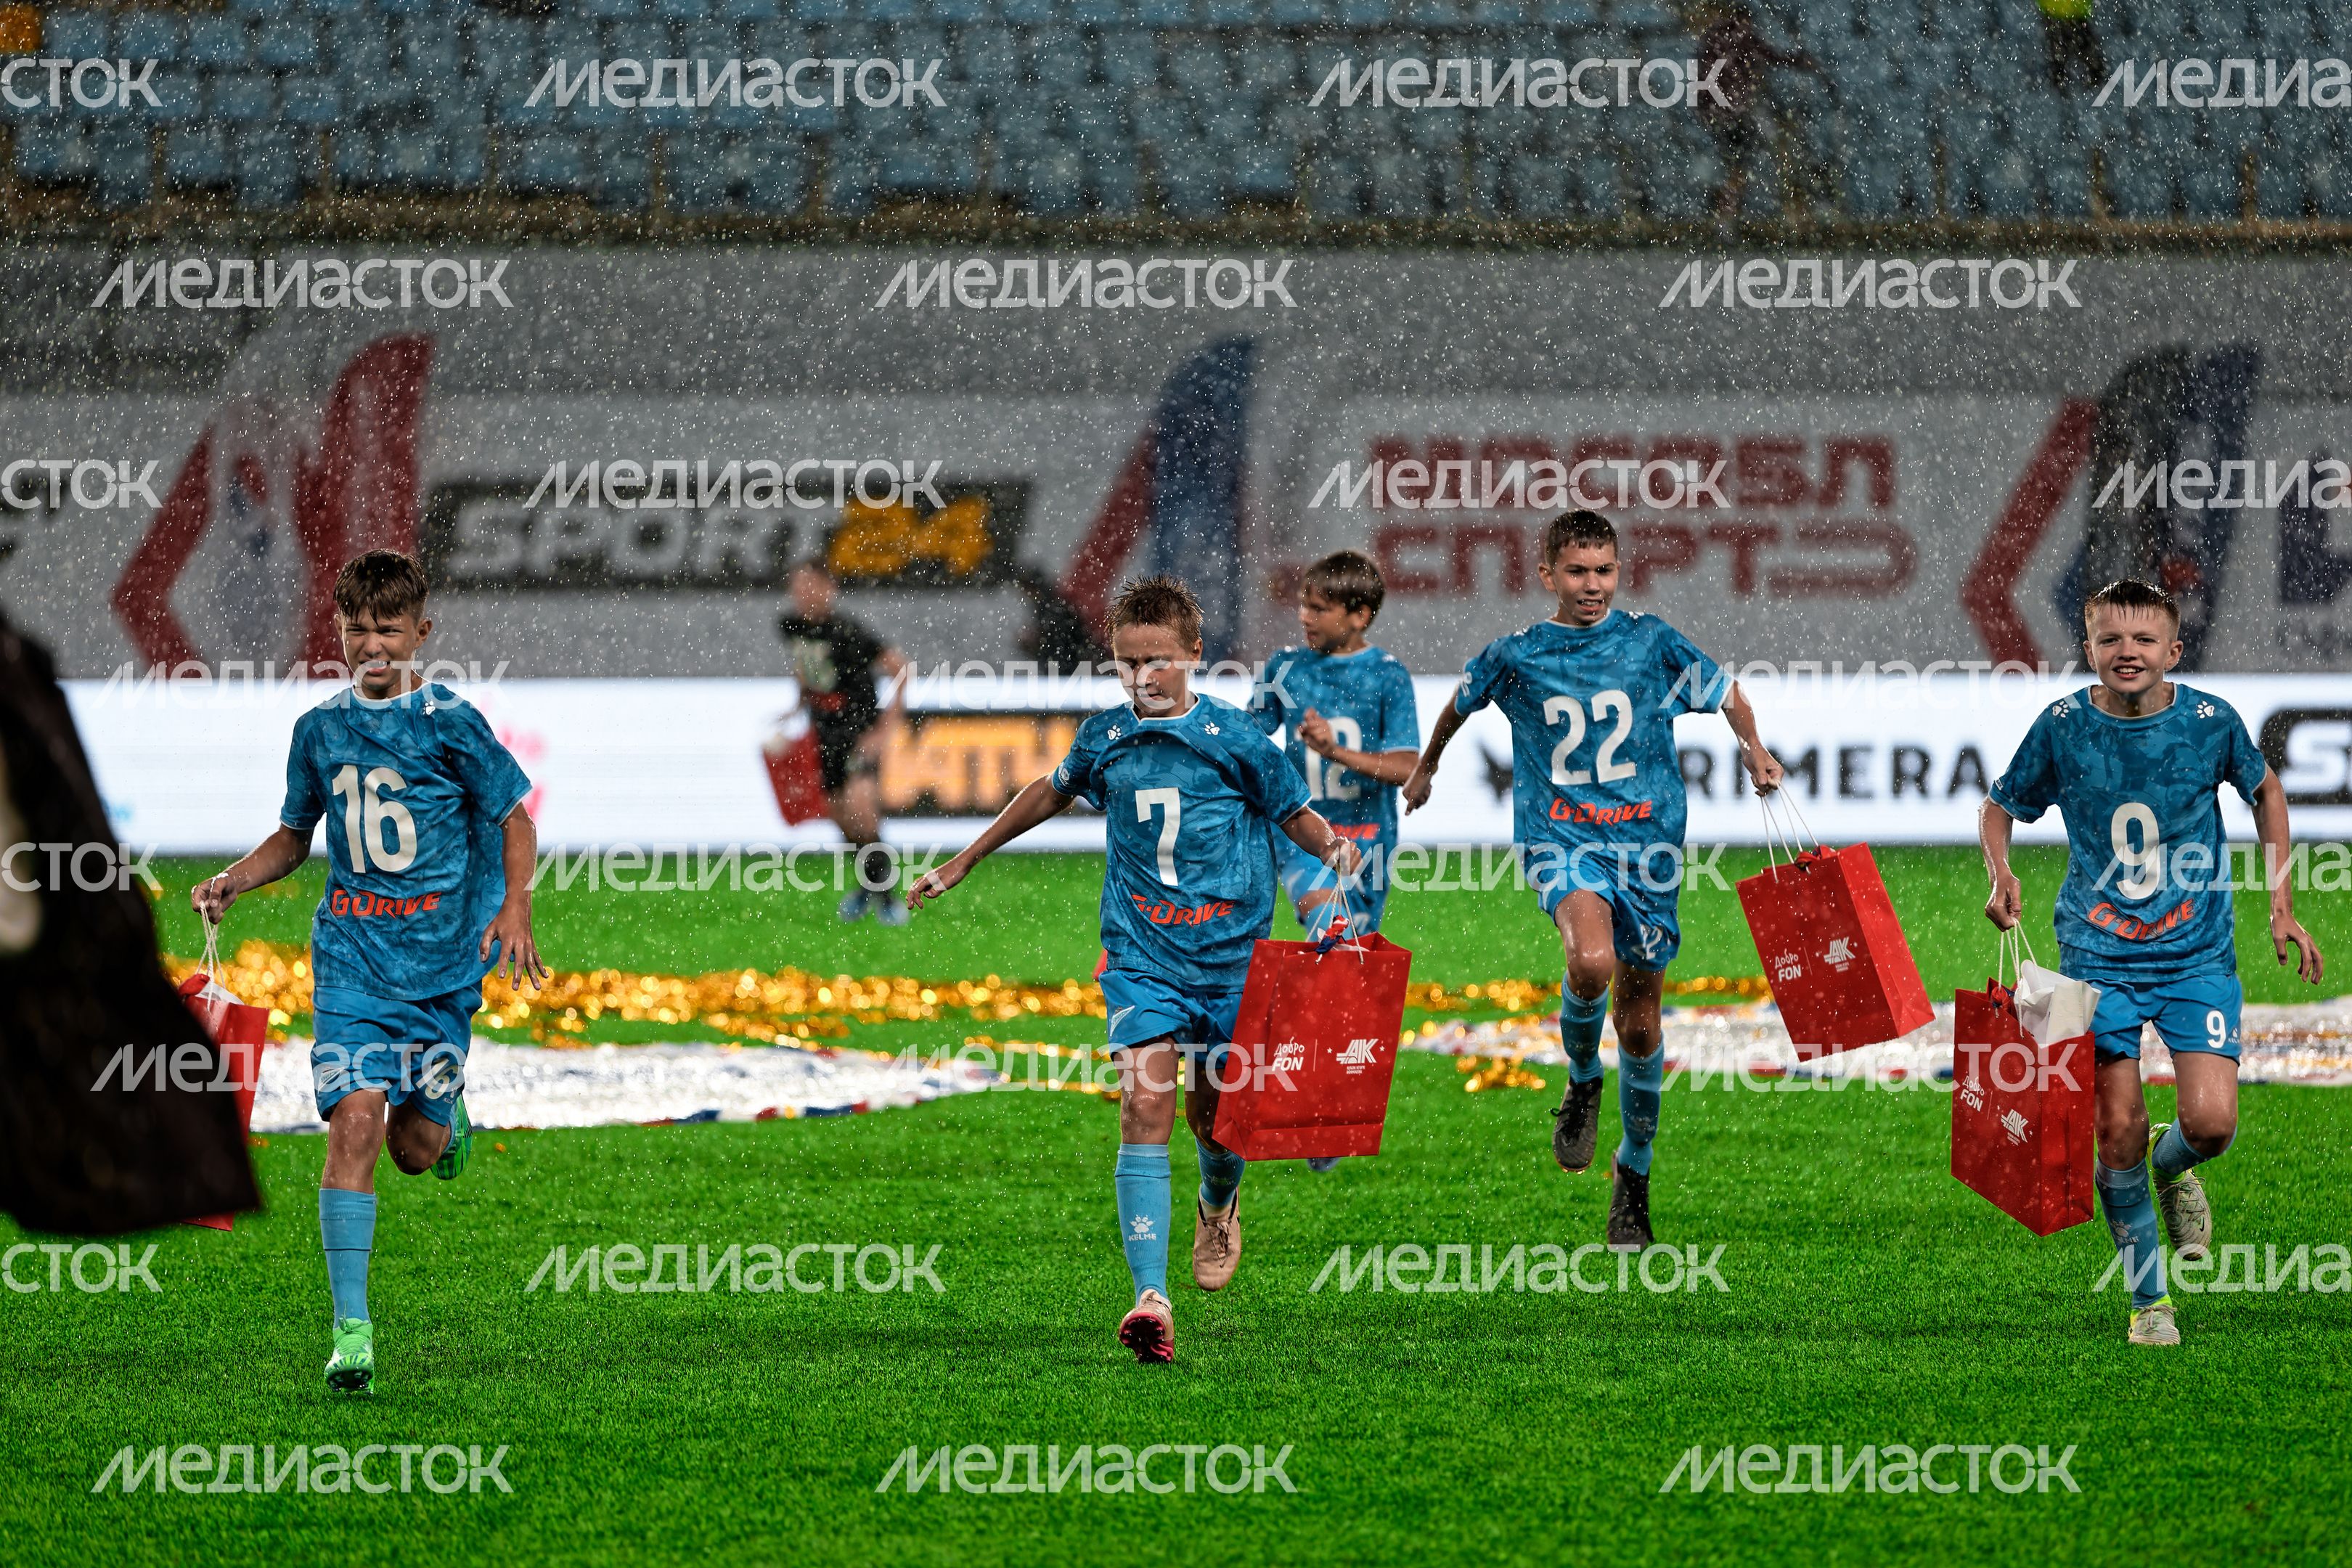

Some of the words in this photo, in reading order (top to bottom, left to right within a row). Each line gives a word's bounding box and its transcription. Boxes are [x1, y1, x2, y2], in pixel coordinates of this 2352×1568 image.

[1371, 522, 1774, 597] СПРТ
[1294, 716, 1363, 801] 12
[1543, 689, 1637, 786] 22
[1678, 745, 1988, 799] RIMERA
[332, 764, 418, 874] 16
[1135, 788, 1181, 887] 7
[2110, 801, 2162, 901] 9
[1778, 964, 1802, 983] FON
[2206, 1010, 2226, 1049] 9
[1271, 1056, 1304, 1072] FON
[1959, 1088, 1984, 1112] FON
[1128, 1233, 1157, 1242] KELME
